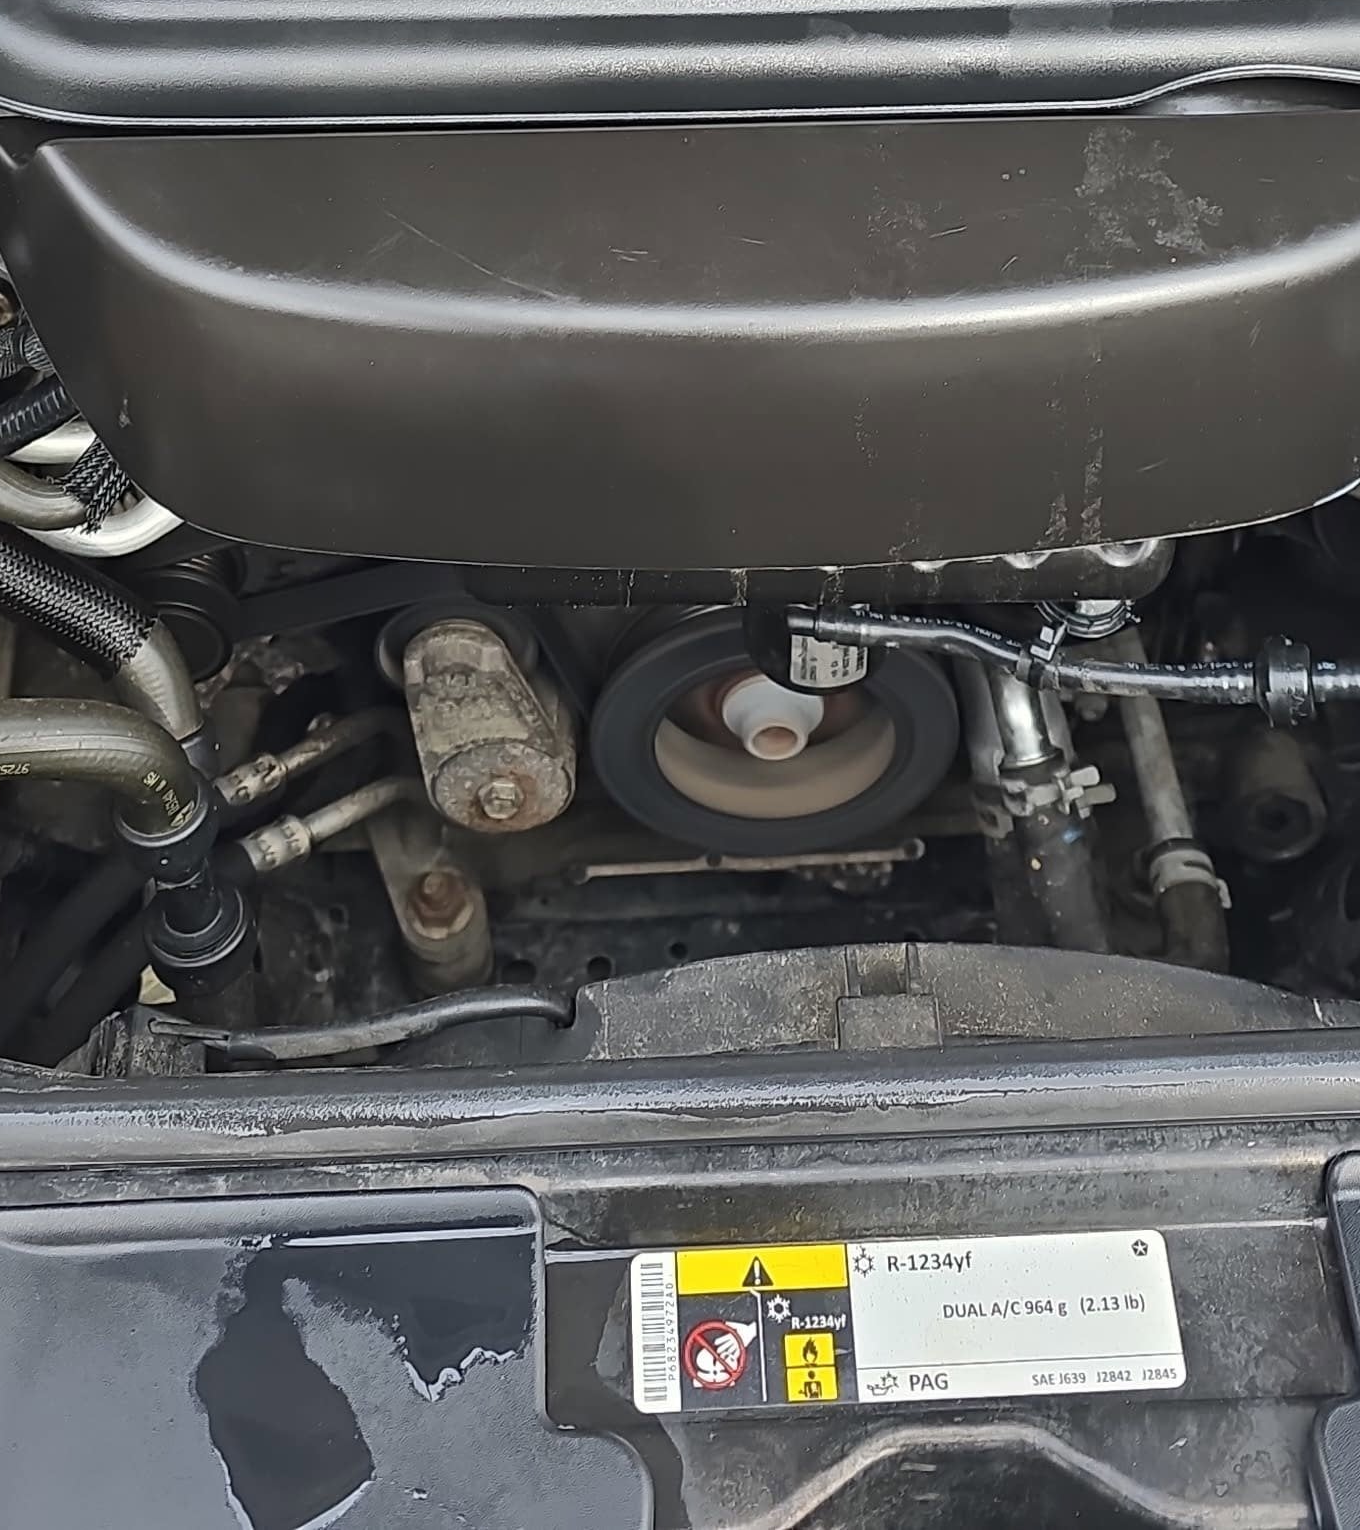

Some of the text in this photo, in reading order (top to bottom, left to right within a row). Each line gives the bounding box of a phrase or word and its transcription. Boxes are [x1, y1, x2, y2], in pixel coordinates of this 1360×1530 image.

[888, 1251, 973, 1274] R-1234yf
[943, 1294, 1146, 1319] DUAL A/C 964 g (2.13 lb)
[665, 1282, 676, 1382] P68234972AD
[791, 1314, 846, 1330] R-1234yf
[909, 1372, 949, 1392] PAG
[1032, 1367, 1177, 1387] SAE J639 J2842 J2845
